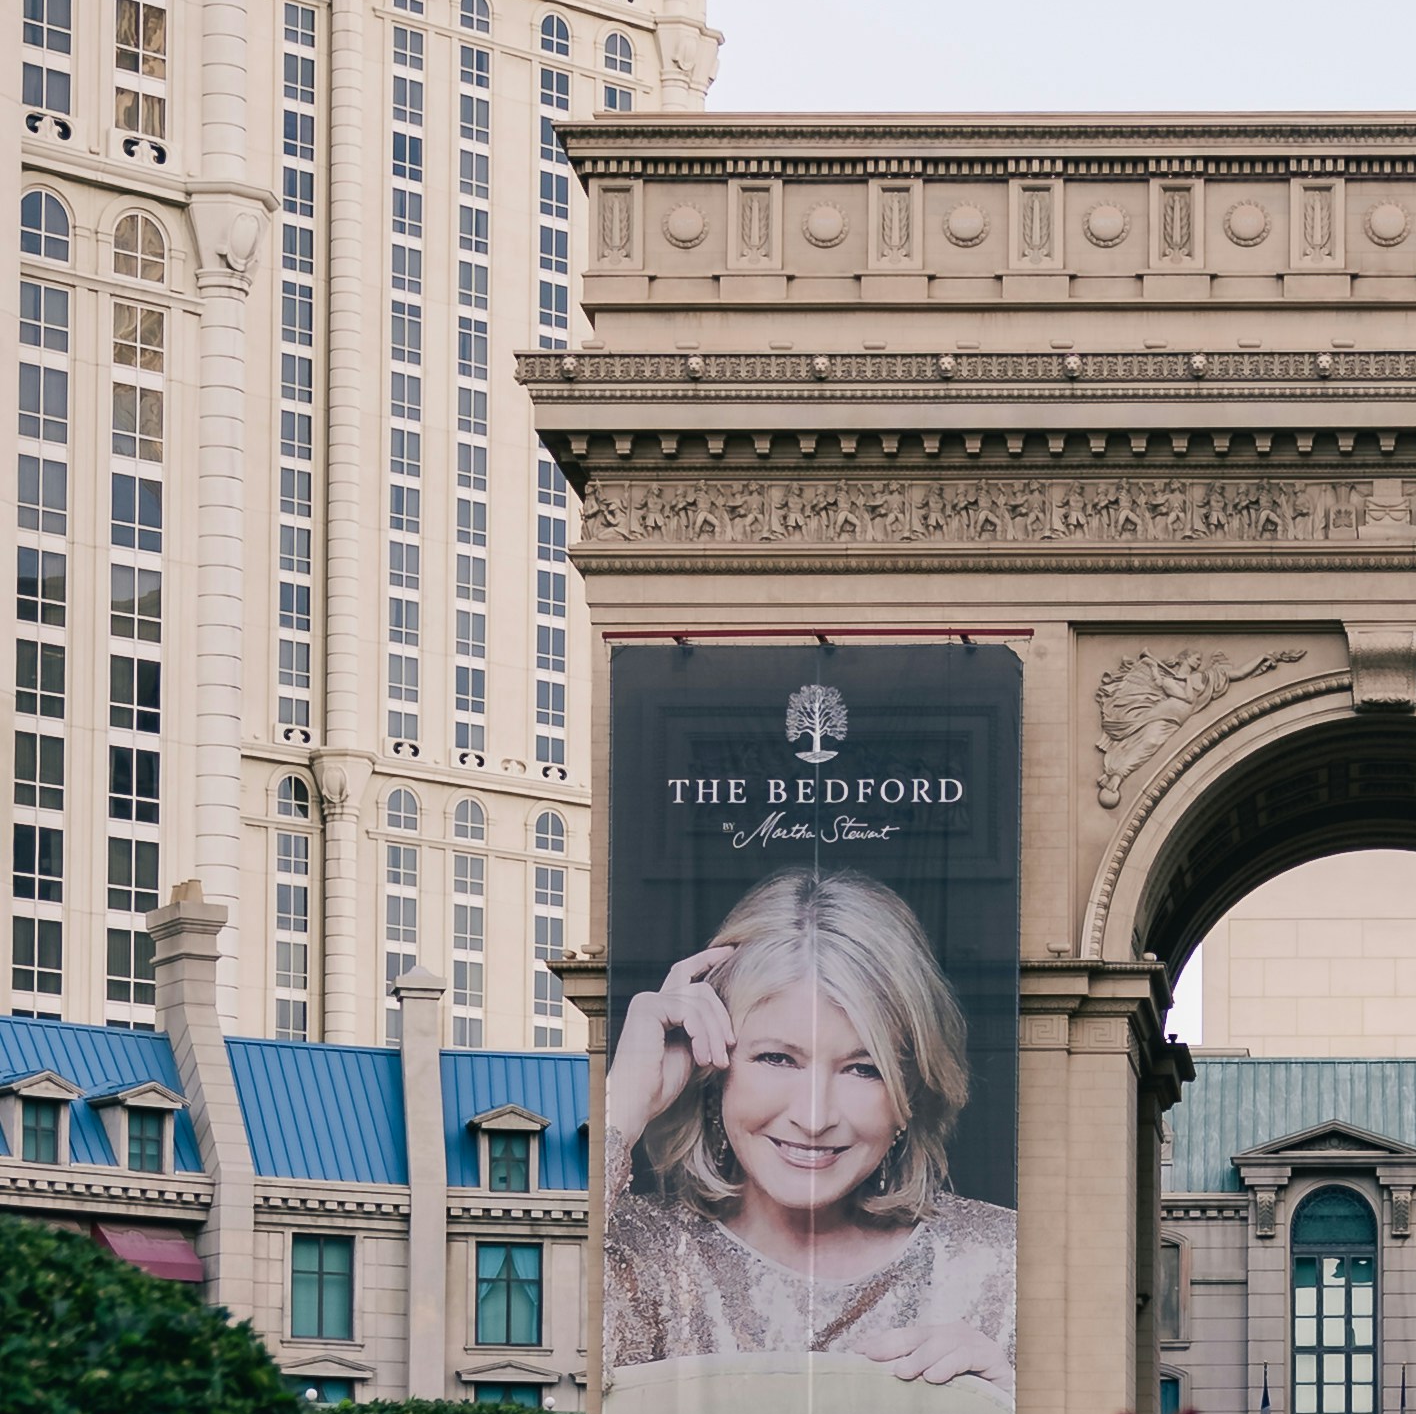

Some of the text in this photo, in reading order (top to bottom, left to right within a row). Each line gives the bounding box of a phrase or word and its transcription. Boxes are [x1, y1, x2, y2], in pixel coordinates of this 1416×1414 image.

[668, 778, 964, 804] THE BEDFORD
[722, 810, 900, 849] BY Martha Stewart
